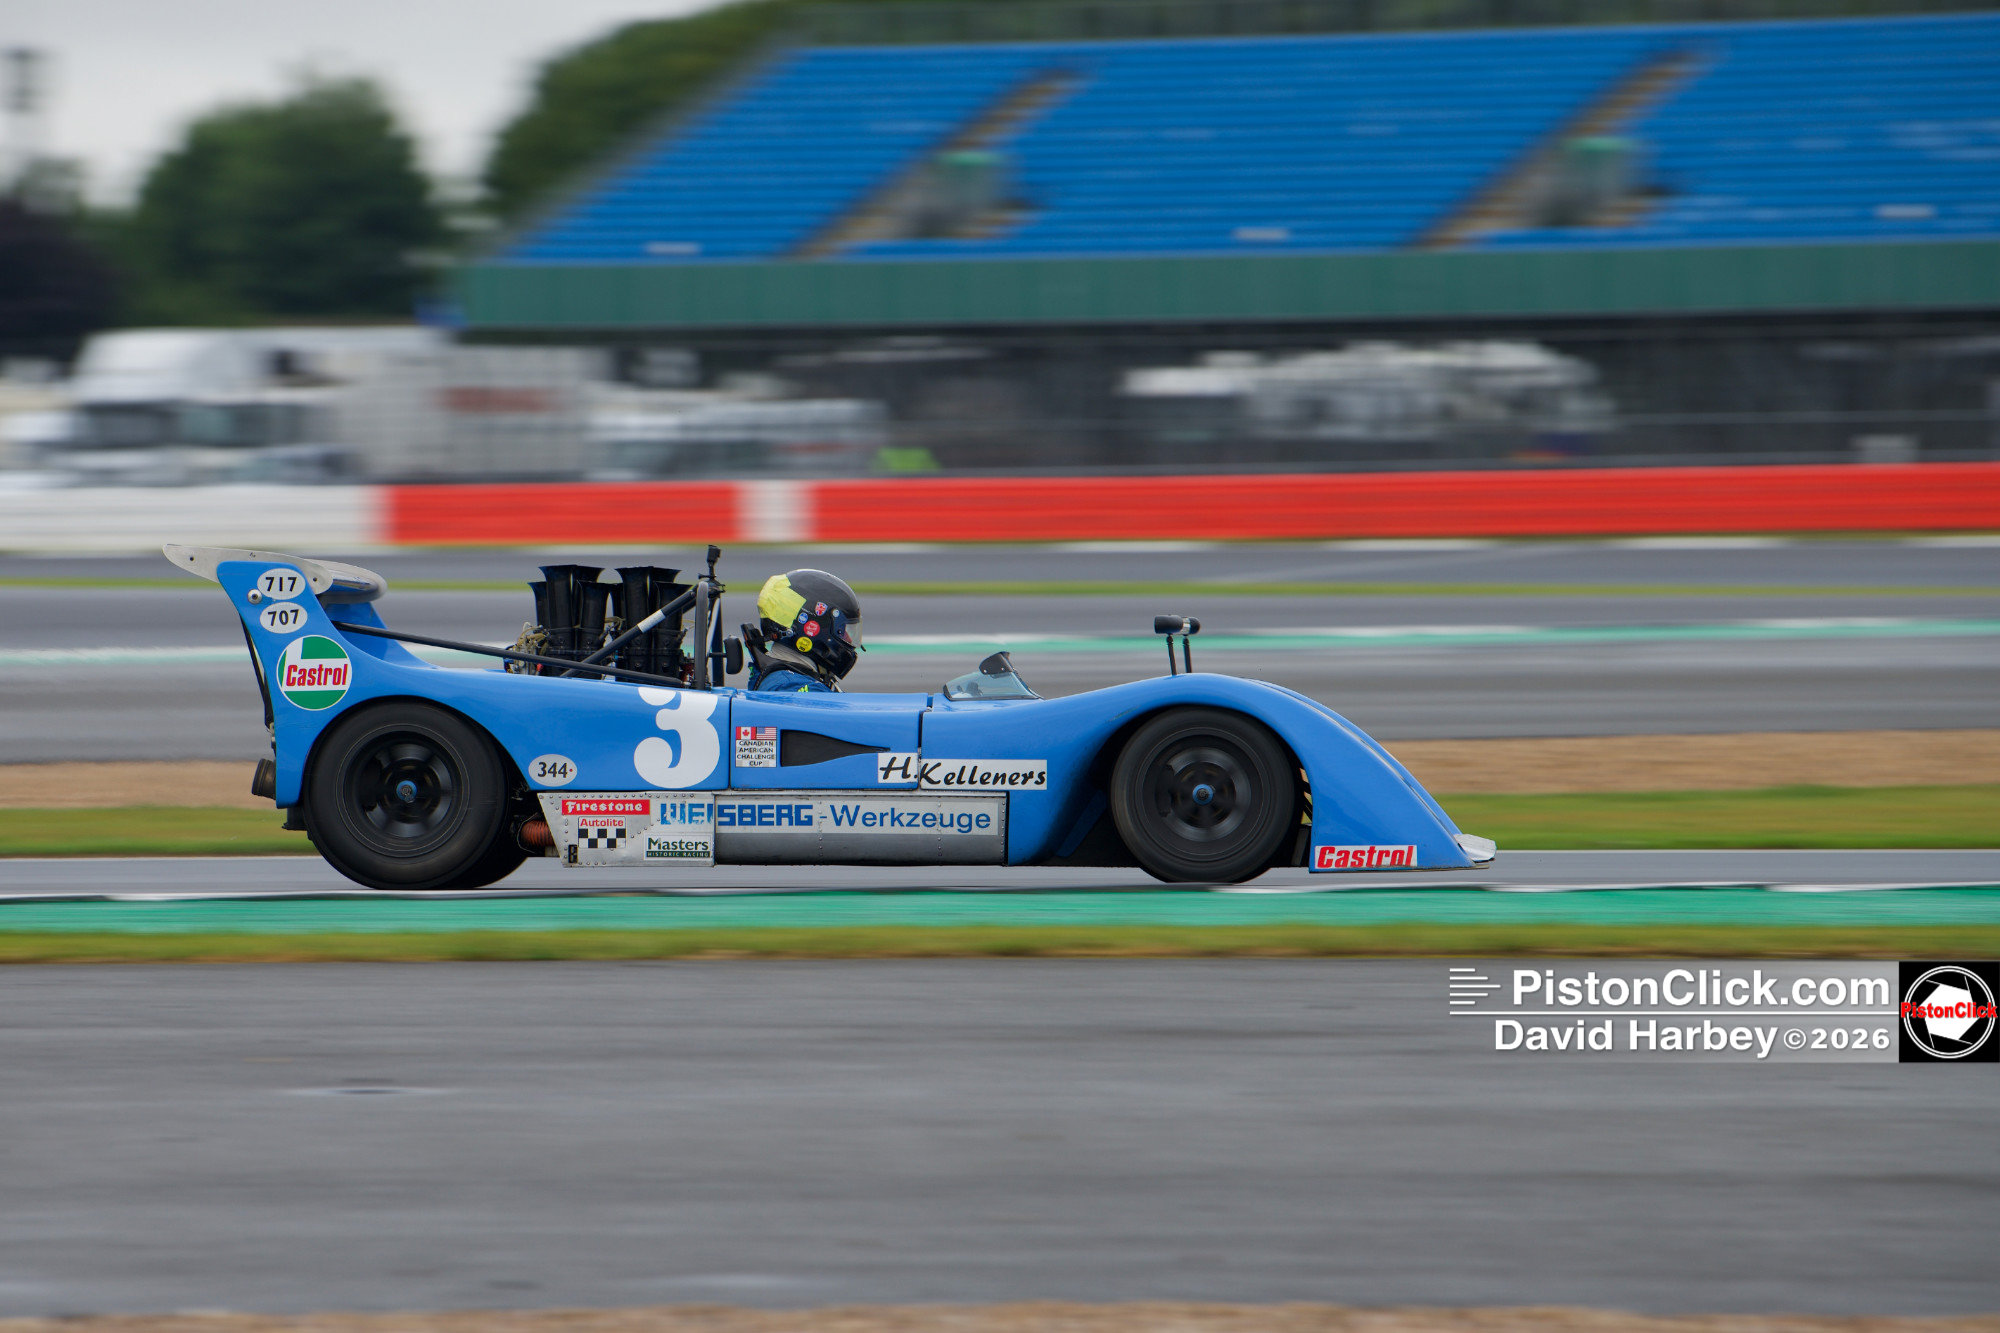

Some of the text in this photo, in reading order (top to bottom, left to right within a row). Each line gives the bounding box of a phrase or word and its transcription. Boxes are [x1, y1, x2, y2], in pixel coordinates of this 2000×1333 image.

[265, 576, 298, 592] 717
[267, 609, 300, 626] 707
[286, 664, 349, 687] Castrol
[633, 687, 720, 788] 3
[537, 761, 568, 778] 344
[879, 756, 1046, 785] H. Kelleners
[566, 801, 643, 813] Firestone
[580, 818, 624, 827] Autolite
[647, 837, 709, 850] Masters
[1317, 846, 1414, 868] Castrol
